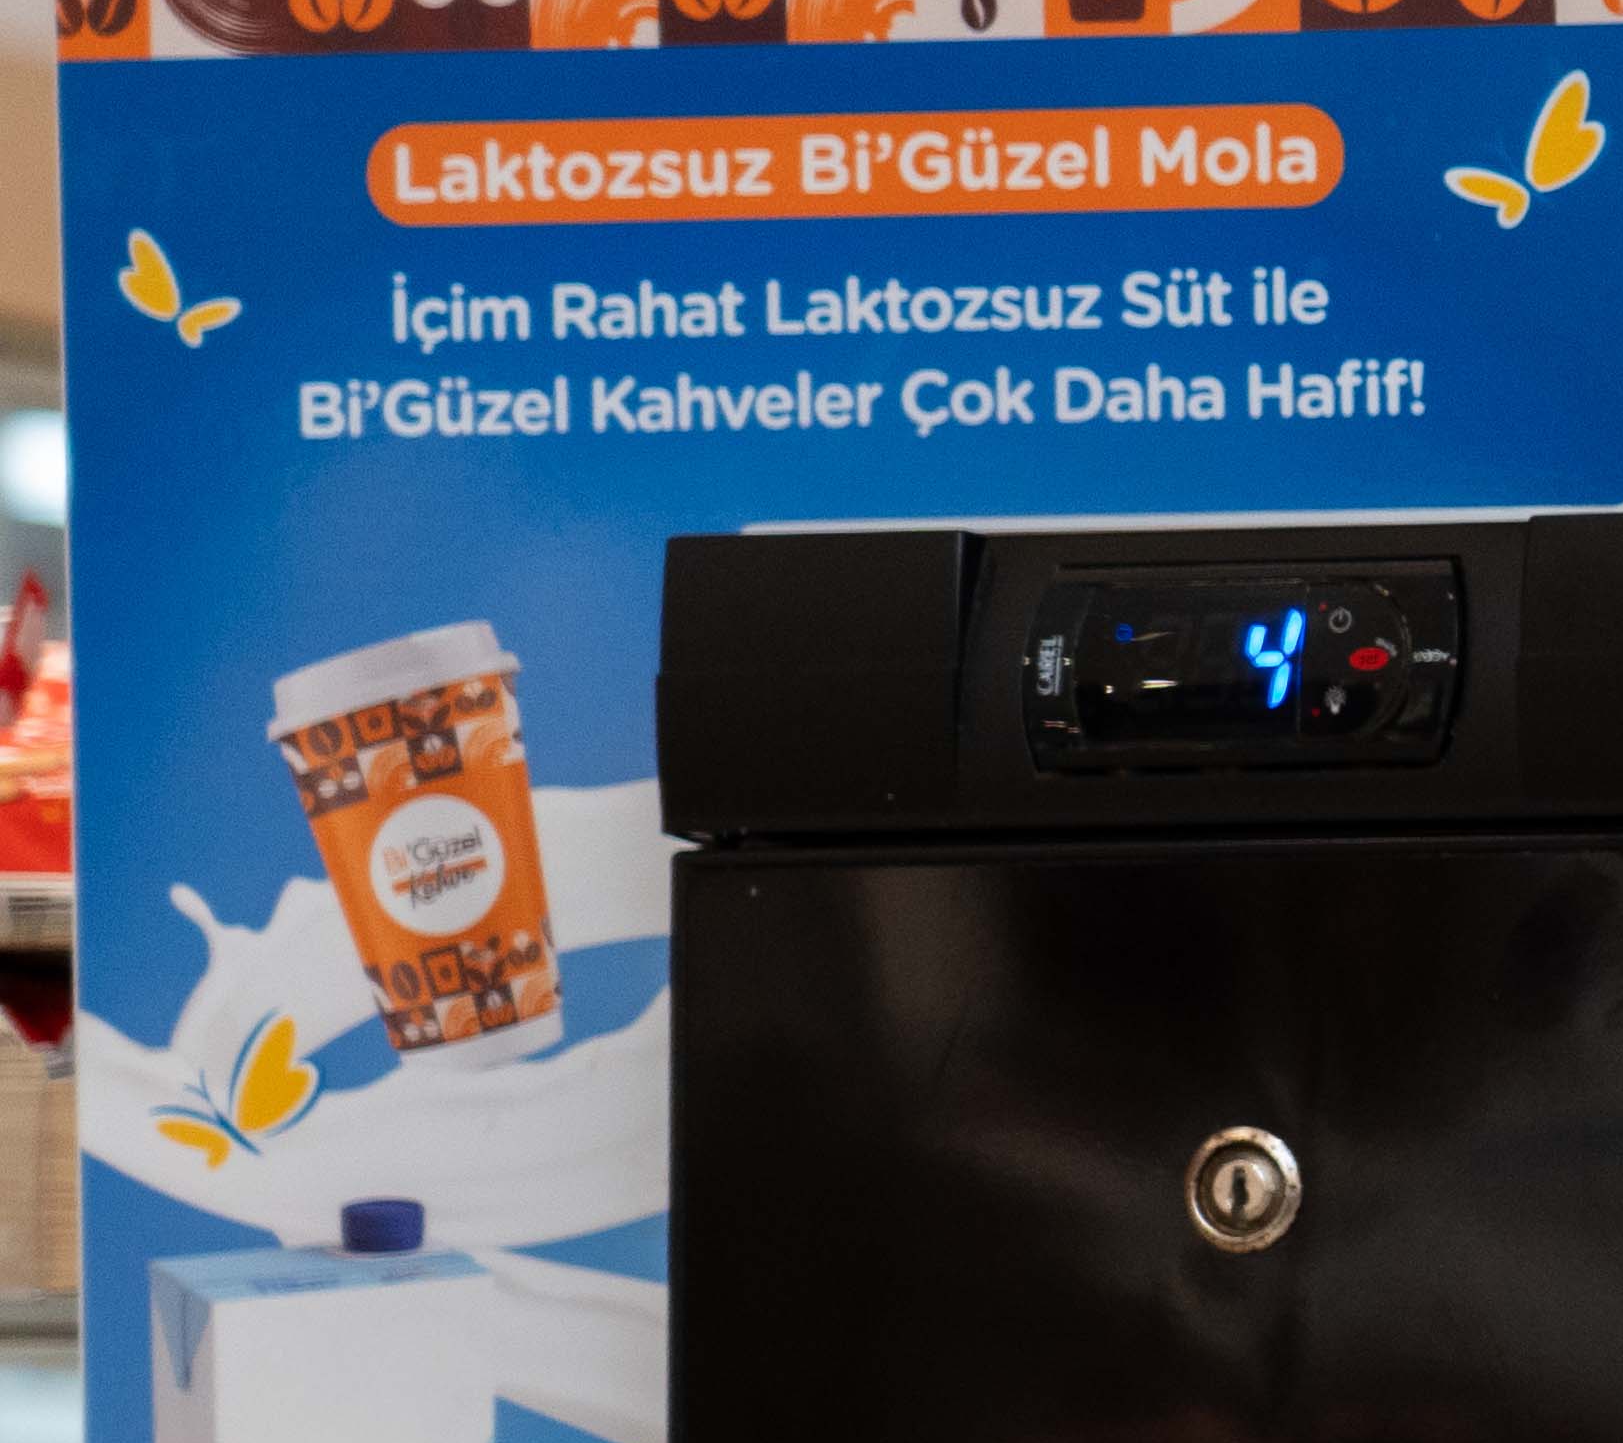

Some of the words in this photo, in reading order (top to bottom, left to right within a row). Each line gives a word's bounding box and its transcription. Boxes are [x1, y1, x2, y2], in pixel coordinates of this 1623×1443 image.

[393, 136, 772, 207] Laktozsuz
[1139, 118, 1321, 190] Mola
[390, 270, 531, 353] İçim
[551, 279, 744, 340] Rahat
[766, 272, 1103, 336] Laktozsuz
[1122, 266, 1233, 329] Süt
[1252, 264, 1330, 326] ile
[589, 368, 881, 435] Kahveler
[901, 364, 1035, 442] Çok
[1053, 362, 1226, 425] Daha
[1245, 356, 1428, 422] Hafif!
[1246, 608, 1306, 709] 4
